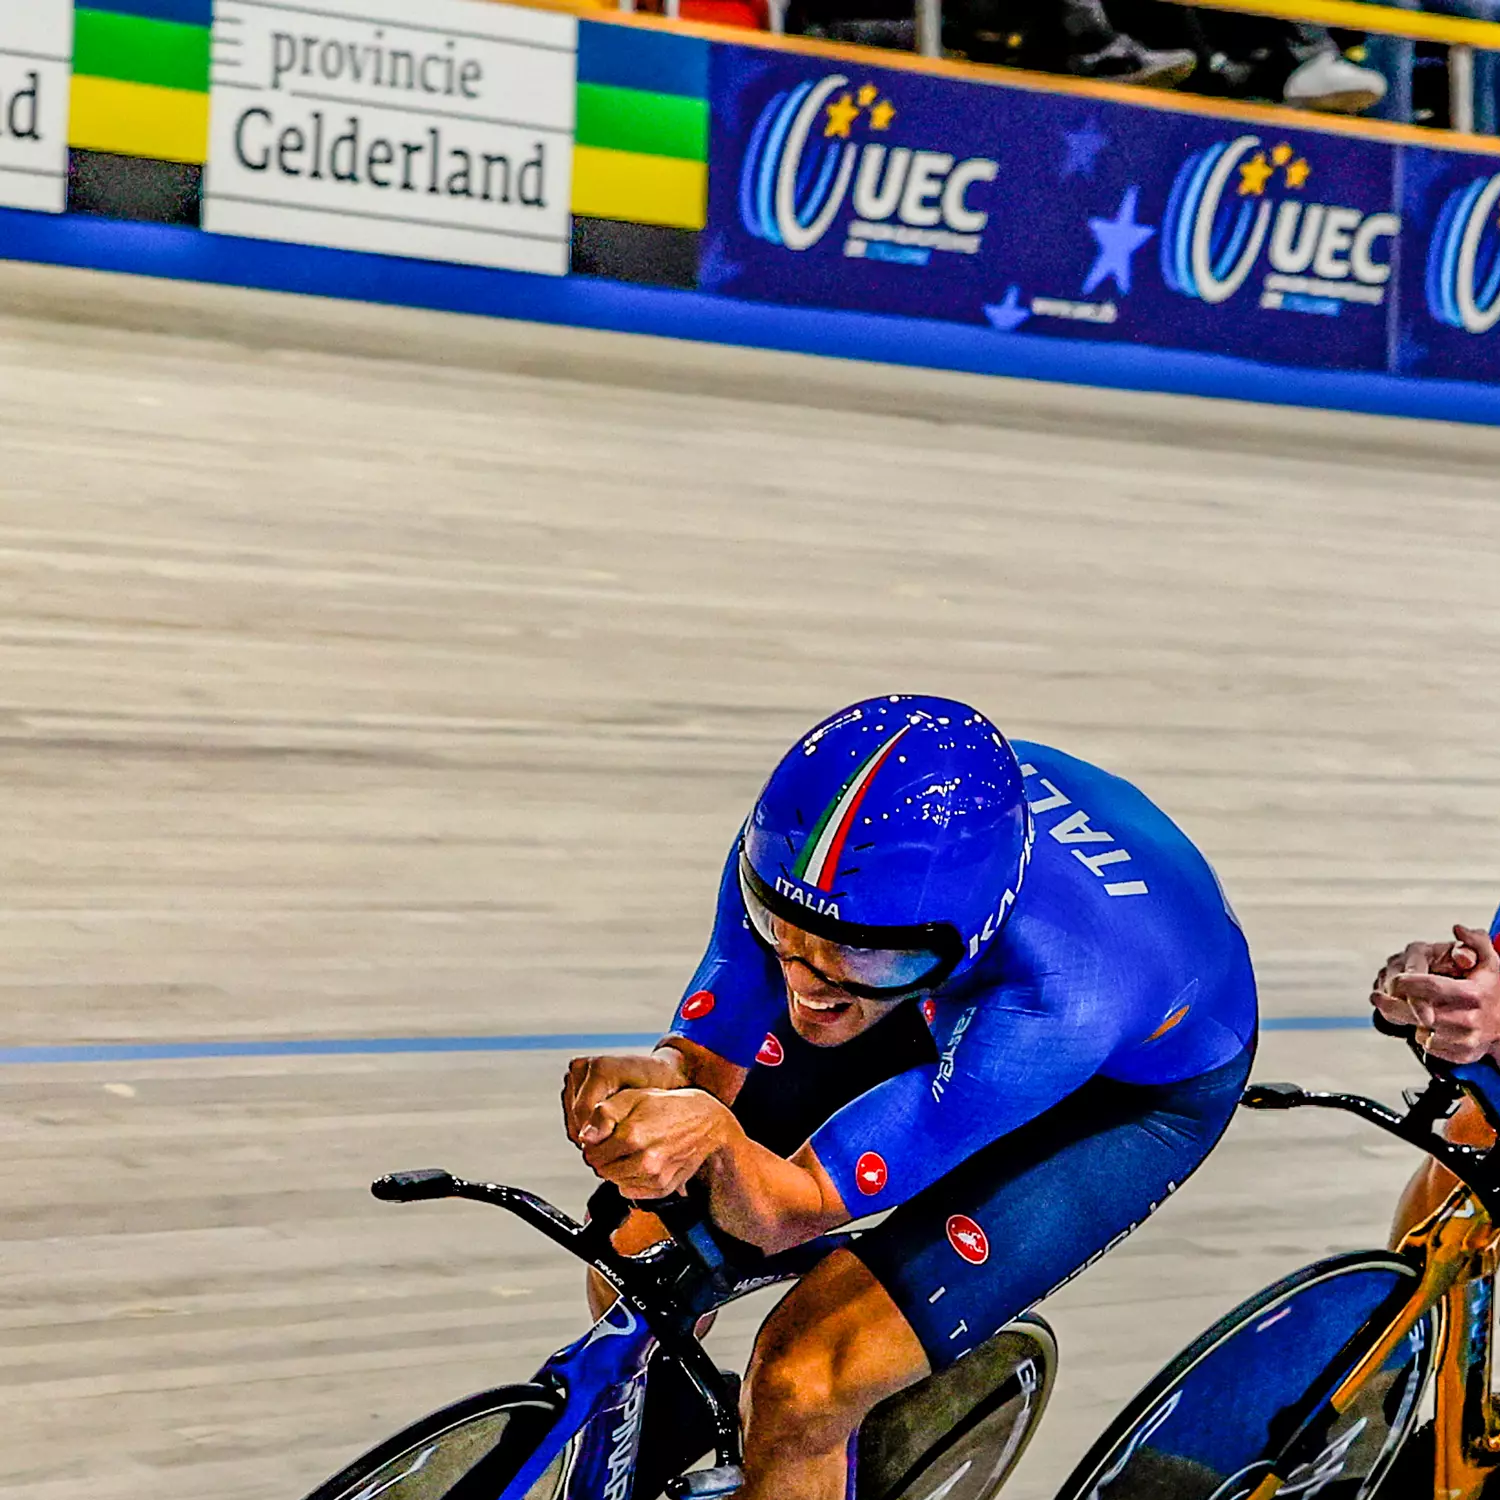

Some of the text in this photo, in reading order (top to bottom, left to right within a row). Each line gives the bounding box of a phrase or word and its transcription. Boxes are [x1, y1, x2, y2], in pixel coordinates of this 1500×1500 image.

[271, 28, 483, 99] provincie
[233, 107, 548, 209] Gelderland
[854, 143, 999, 231] UEC
[1269, 200, 1399, 284] UEC
[775, 876, 840, 920] ITALIA
